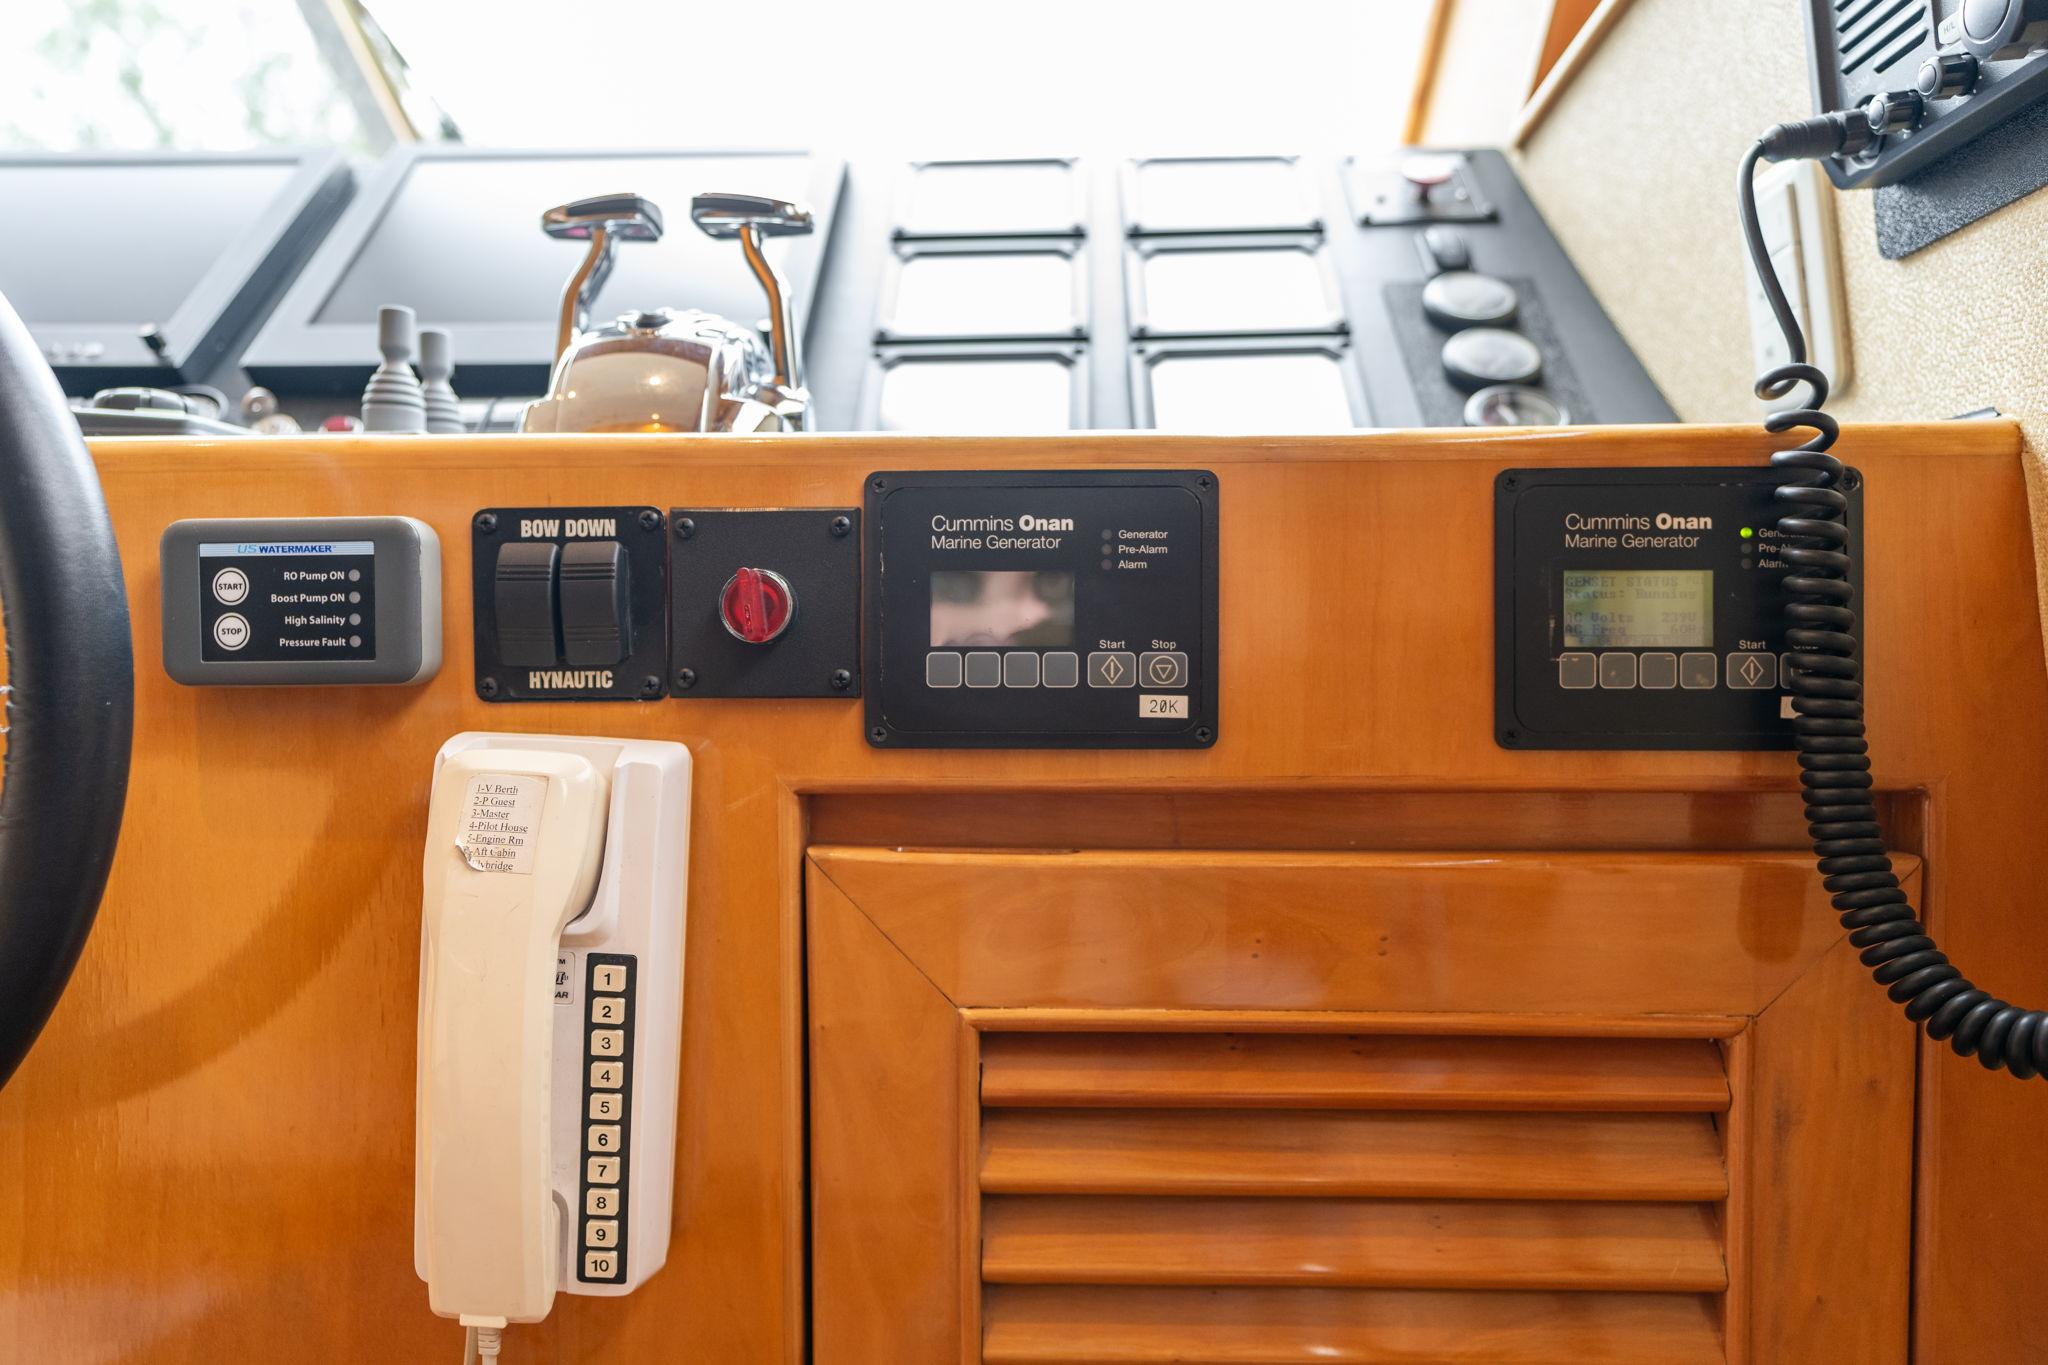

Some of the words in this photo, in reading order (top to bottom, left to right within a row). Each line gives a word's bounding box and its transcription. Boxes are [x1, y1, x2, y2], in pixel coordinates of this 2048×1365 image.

[520, 519, 560, 537] BOW
[565, 518, 616, 537] DOWN
[931, 515, 1014, 532] Cummins
[1018, 514, 1074, 531] Onan
[1565, 513, 1650, 530] Cummins
[1655, 513, 1713, 530] Onan
[1118, 529, 1168, 539] Generator
[931, 535, 982, 549] Marine
[986, 534, 1062, 549] Generator
[1565, 534, 1617, 548] Marine
[1621, 533, 1700, 548] Generator
[259, 544, 332, 554] WATERMAKER
[1118, 545, 1168, 554] Pre-Alarm
[1118, 560, 1147, 569] Alarm
[283, 571, 298, 581] RO
[300, 571, 328, 583] Pump
[329, 571, 345, 581] ON
[218, 582, 243, 591] START
[270, 593, 298, 603] Boost
[300, 593, 328, 604] Pump
[330, 593, 345, 602] ON
[284, 615, 307, 627] High
[309, 615, 346, 627] Salinity
[221, 627, 242, 636] STOP
[279, 637, 320, 648] Pressure
[322, 637, 346, 647] Fault
[1099, 640, 1126, 649] Start
[1151, 640, 1177, 650] Stop
[1738, 640, 1767, 650] Start
[529, 671, 614, 689] HYNAUTIC
[1149, 700, 1178, 713] 20K
[495, 784, 519, 794] Berth
[490, 796, 516, 806] Guest
[472, 808, 510, 819] 3-Master
[469, 821, 498, 831] 4-Pilot
[500, 822, 529, 833] House
[508, 835, 524, 845] Rm
[490, 848, 516, 858] Cabin
[604, 973, 611, 985] 1
[602, 1006, 612, 1018] 2
[601, 1037, 611, 1050] 3
[601, 1070, 611, 1082] 4
[600, 1101, 610, 1113] 5
[598, 1133, 608, 1146] 6
[597, 1165, 607, 1177] 7
[596, 1197, 607, 1209] 8
[595, 1228, 606, 1241] 9
[591, 1260, 609, 1272] 10
